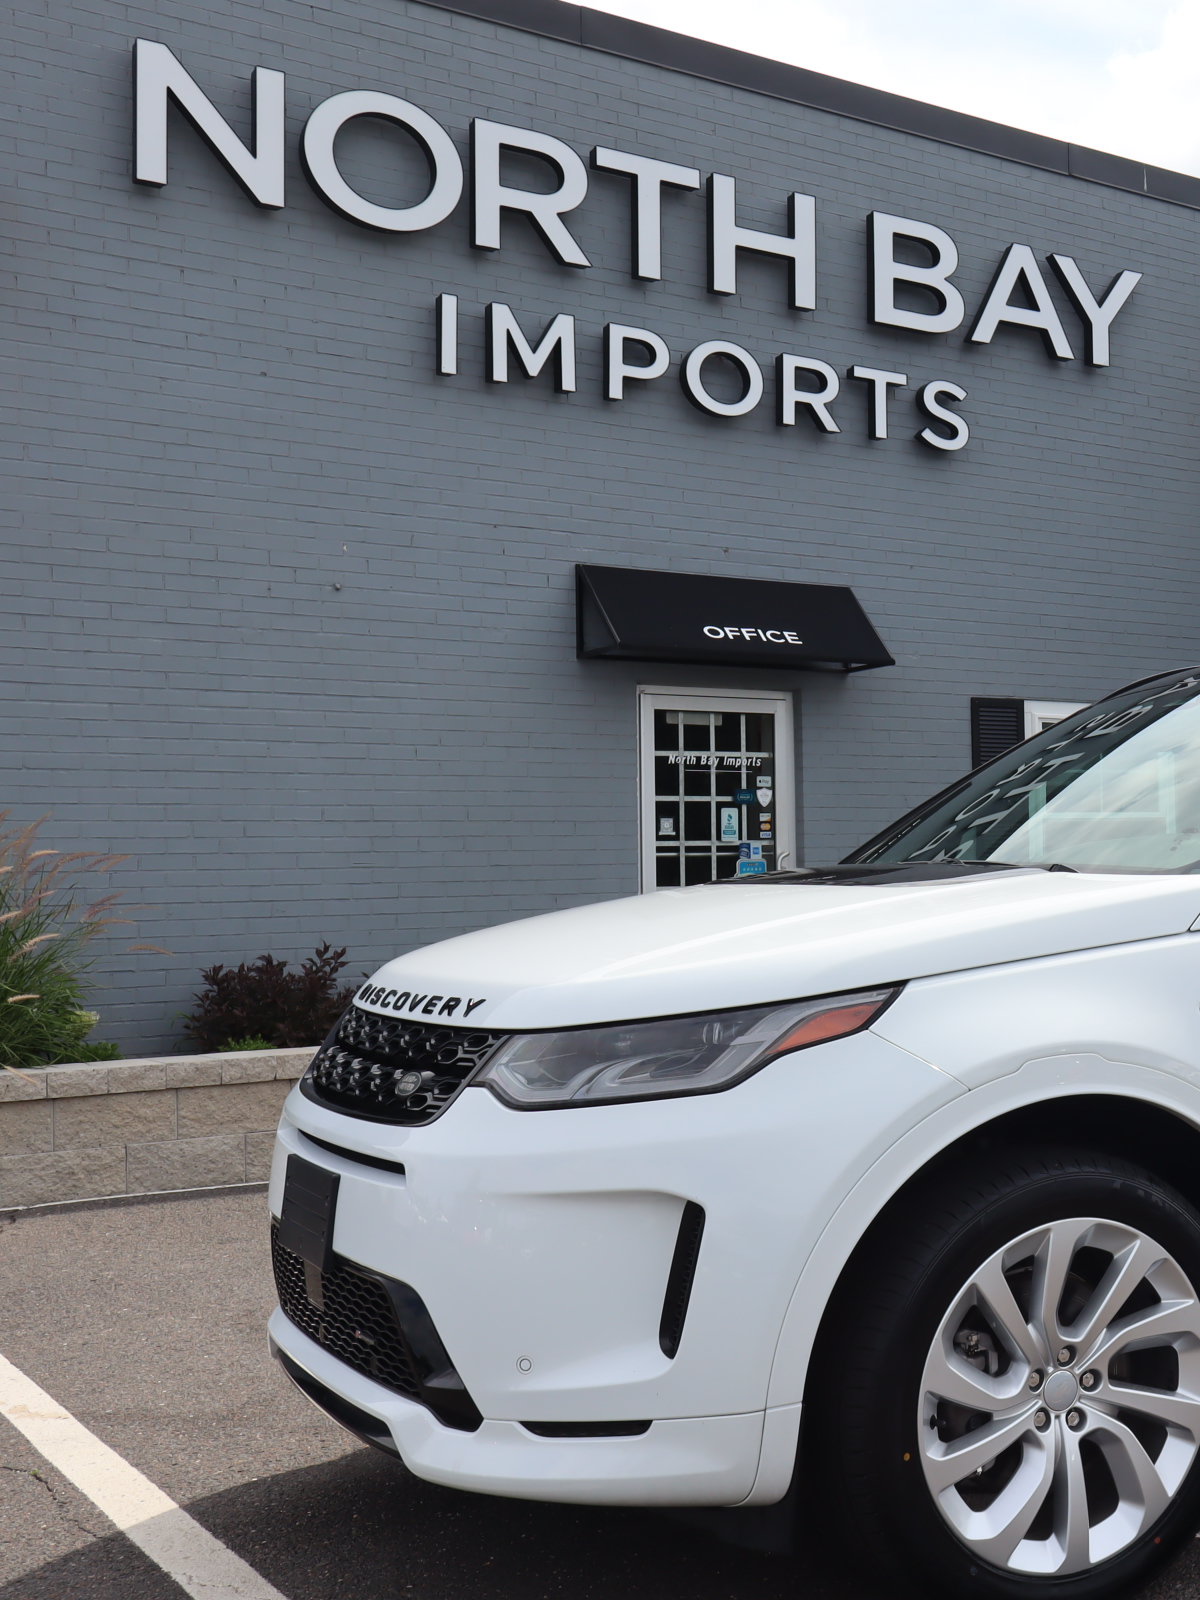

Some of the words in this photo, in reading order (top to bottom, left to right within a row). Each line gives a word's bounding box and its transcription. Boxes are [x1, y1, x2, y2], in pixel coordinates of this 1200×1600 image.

[134, 38, 815, 311] NORTH
[868, 211, 1143, 367] BAY
[437, 293, 969, 451] IMPORTS
[702, 625, 803, 645] OFFICE
[668, 754, 697, 765] North
[700, 755, 719, 768] Bay
[723, 755, 762, 768] Imports
[358, 983, 486, 1018] DISCOVERY
